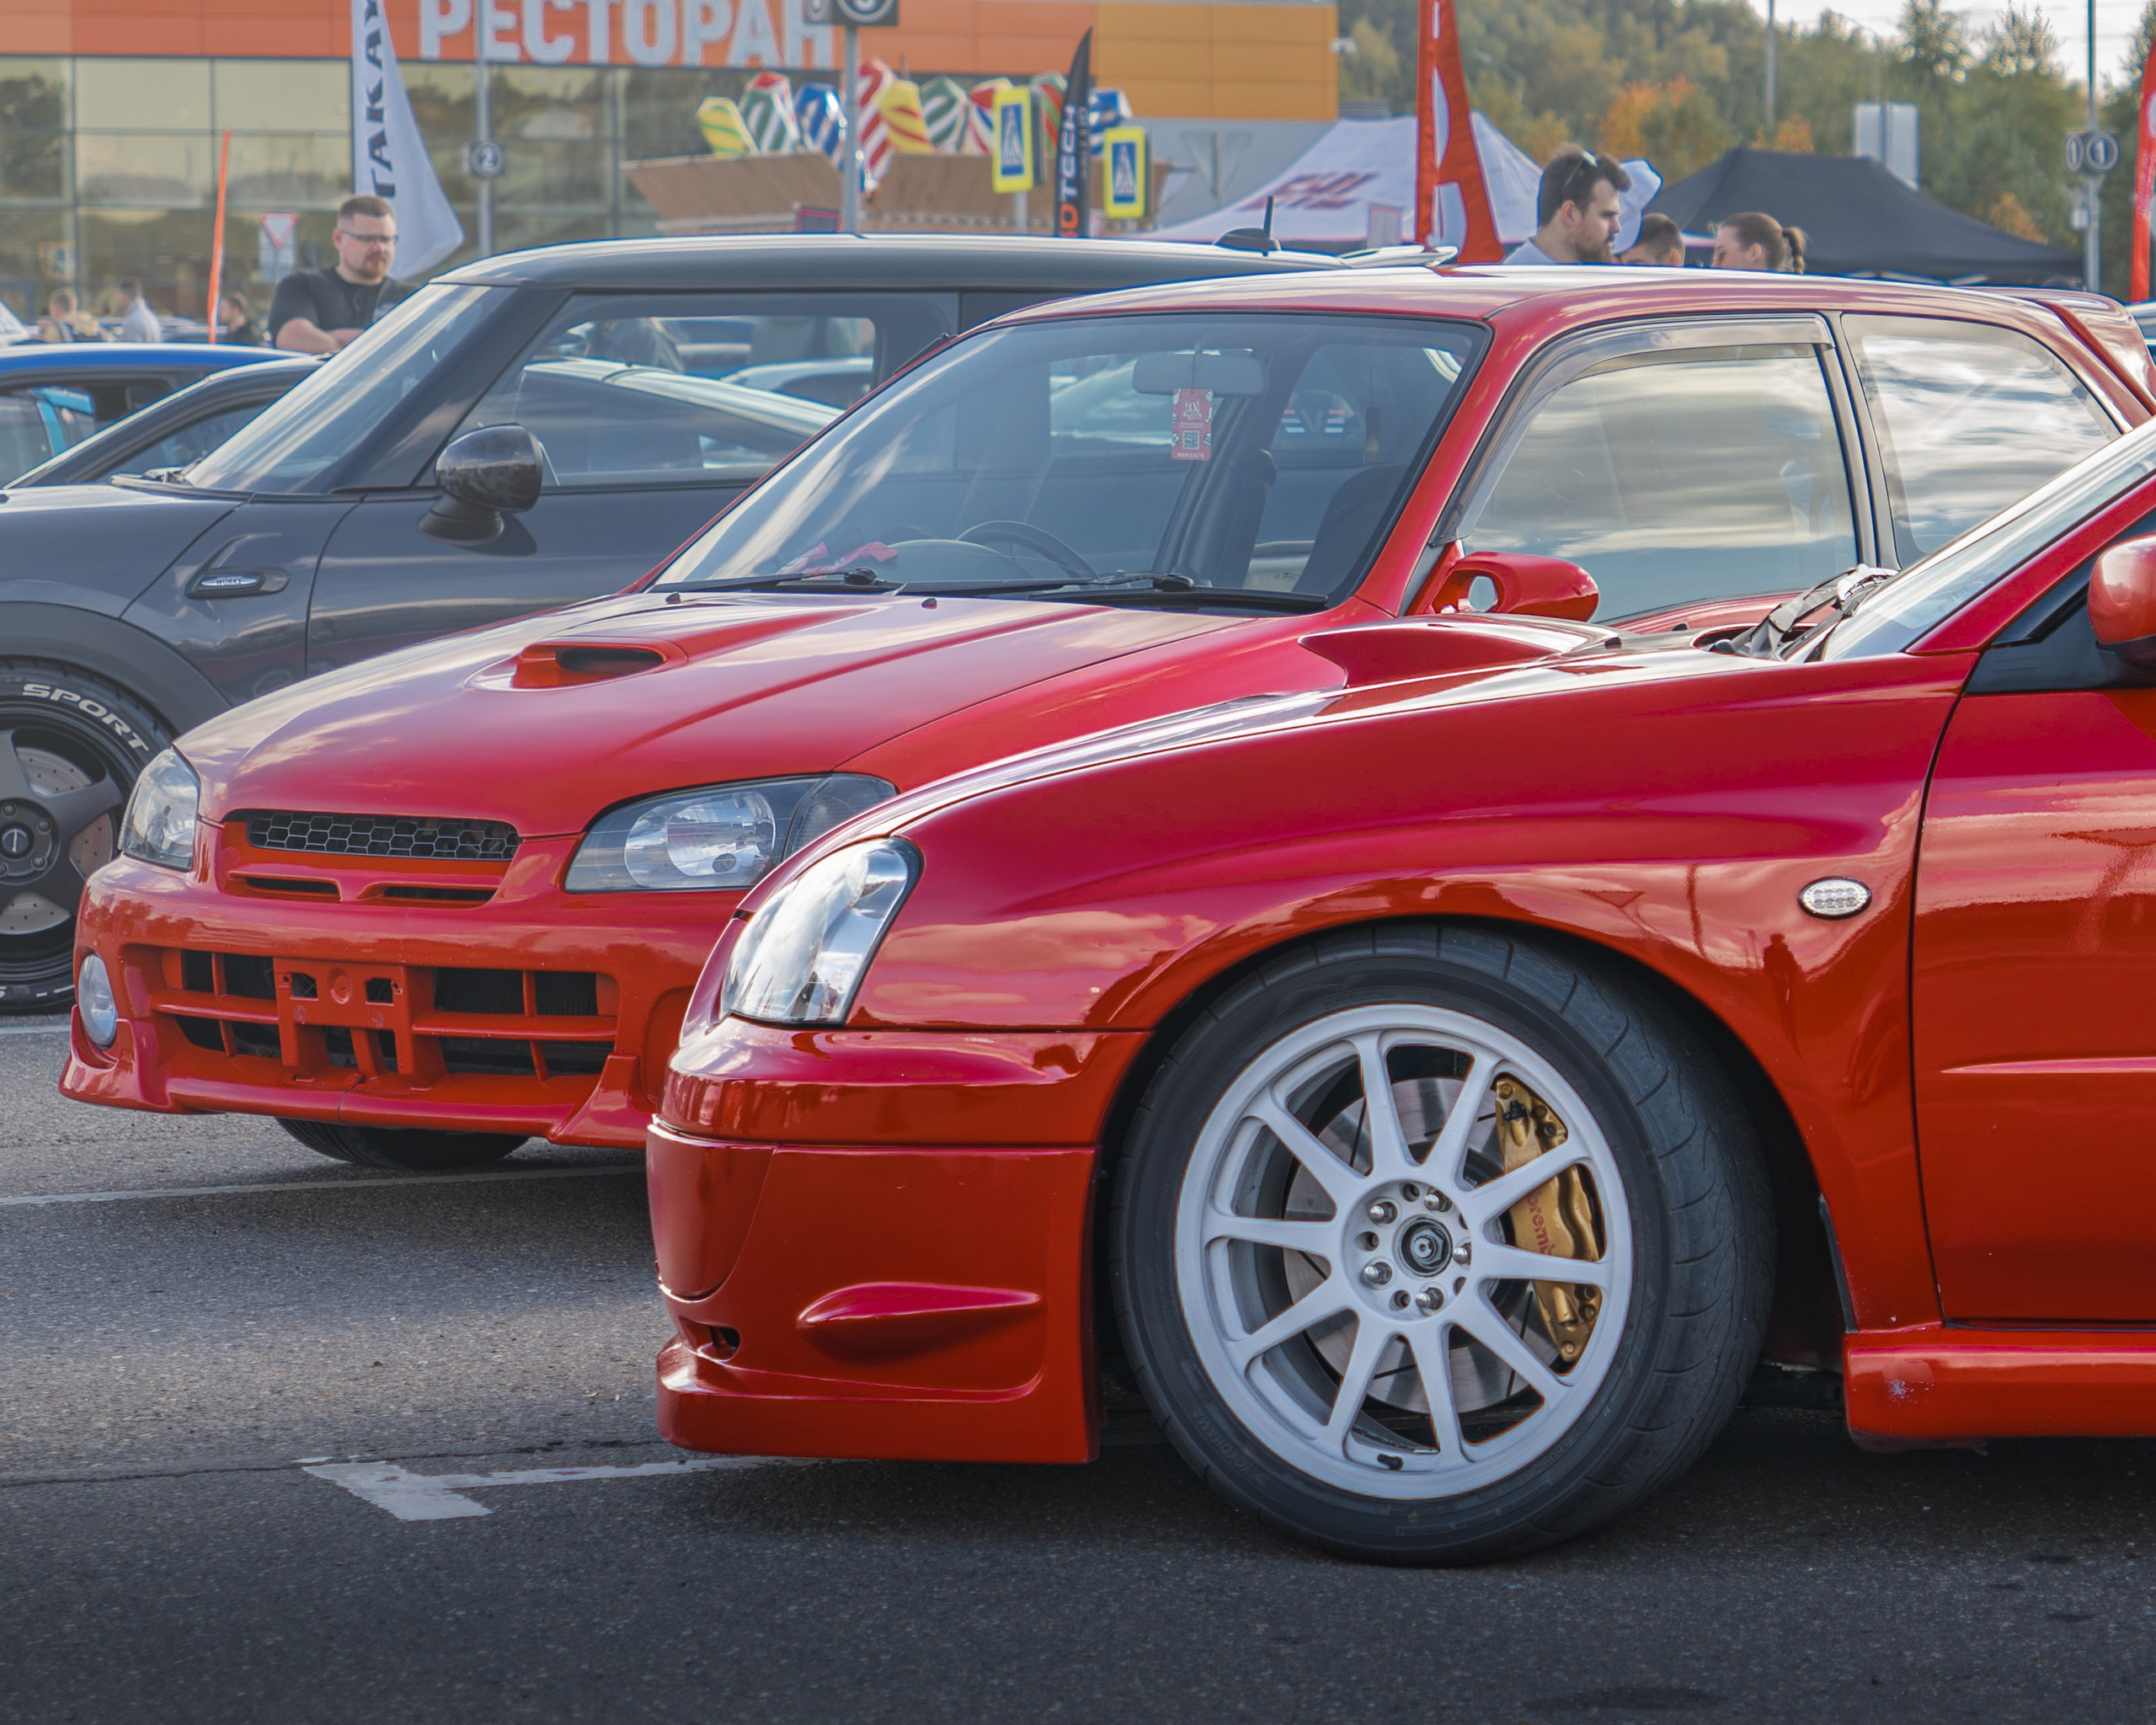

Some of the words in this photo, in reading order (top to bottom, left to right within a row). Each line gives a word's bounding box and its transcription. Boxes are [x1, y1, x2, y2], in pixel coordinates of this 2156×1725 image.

[419, 0, 833, 67] РЕСТОРАН
[1059, 104, 1079, 237] OTECH
[22, 683, 150, 751] SPORT
